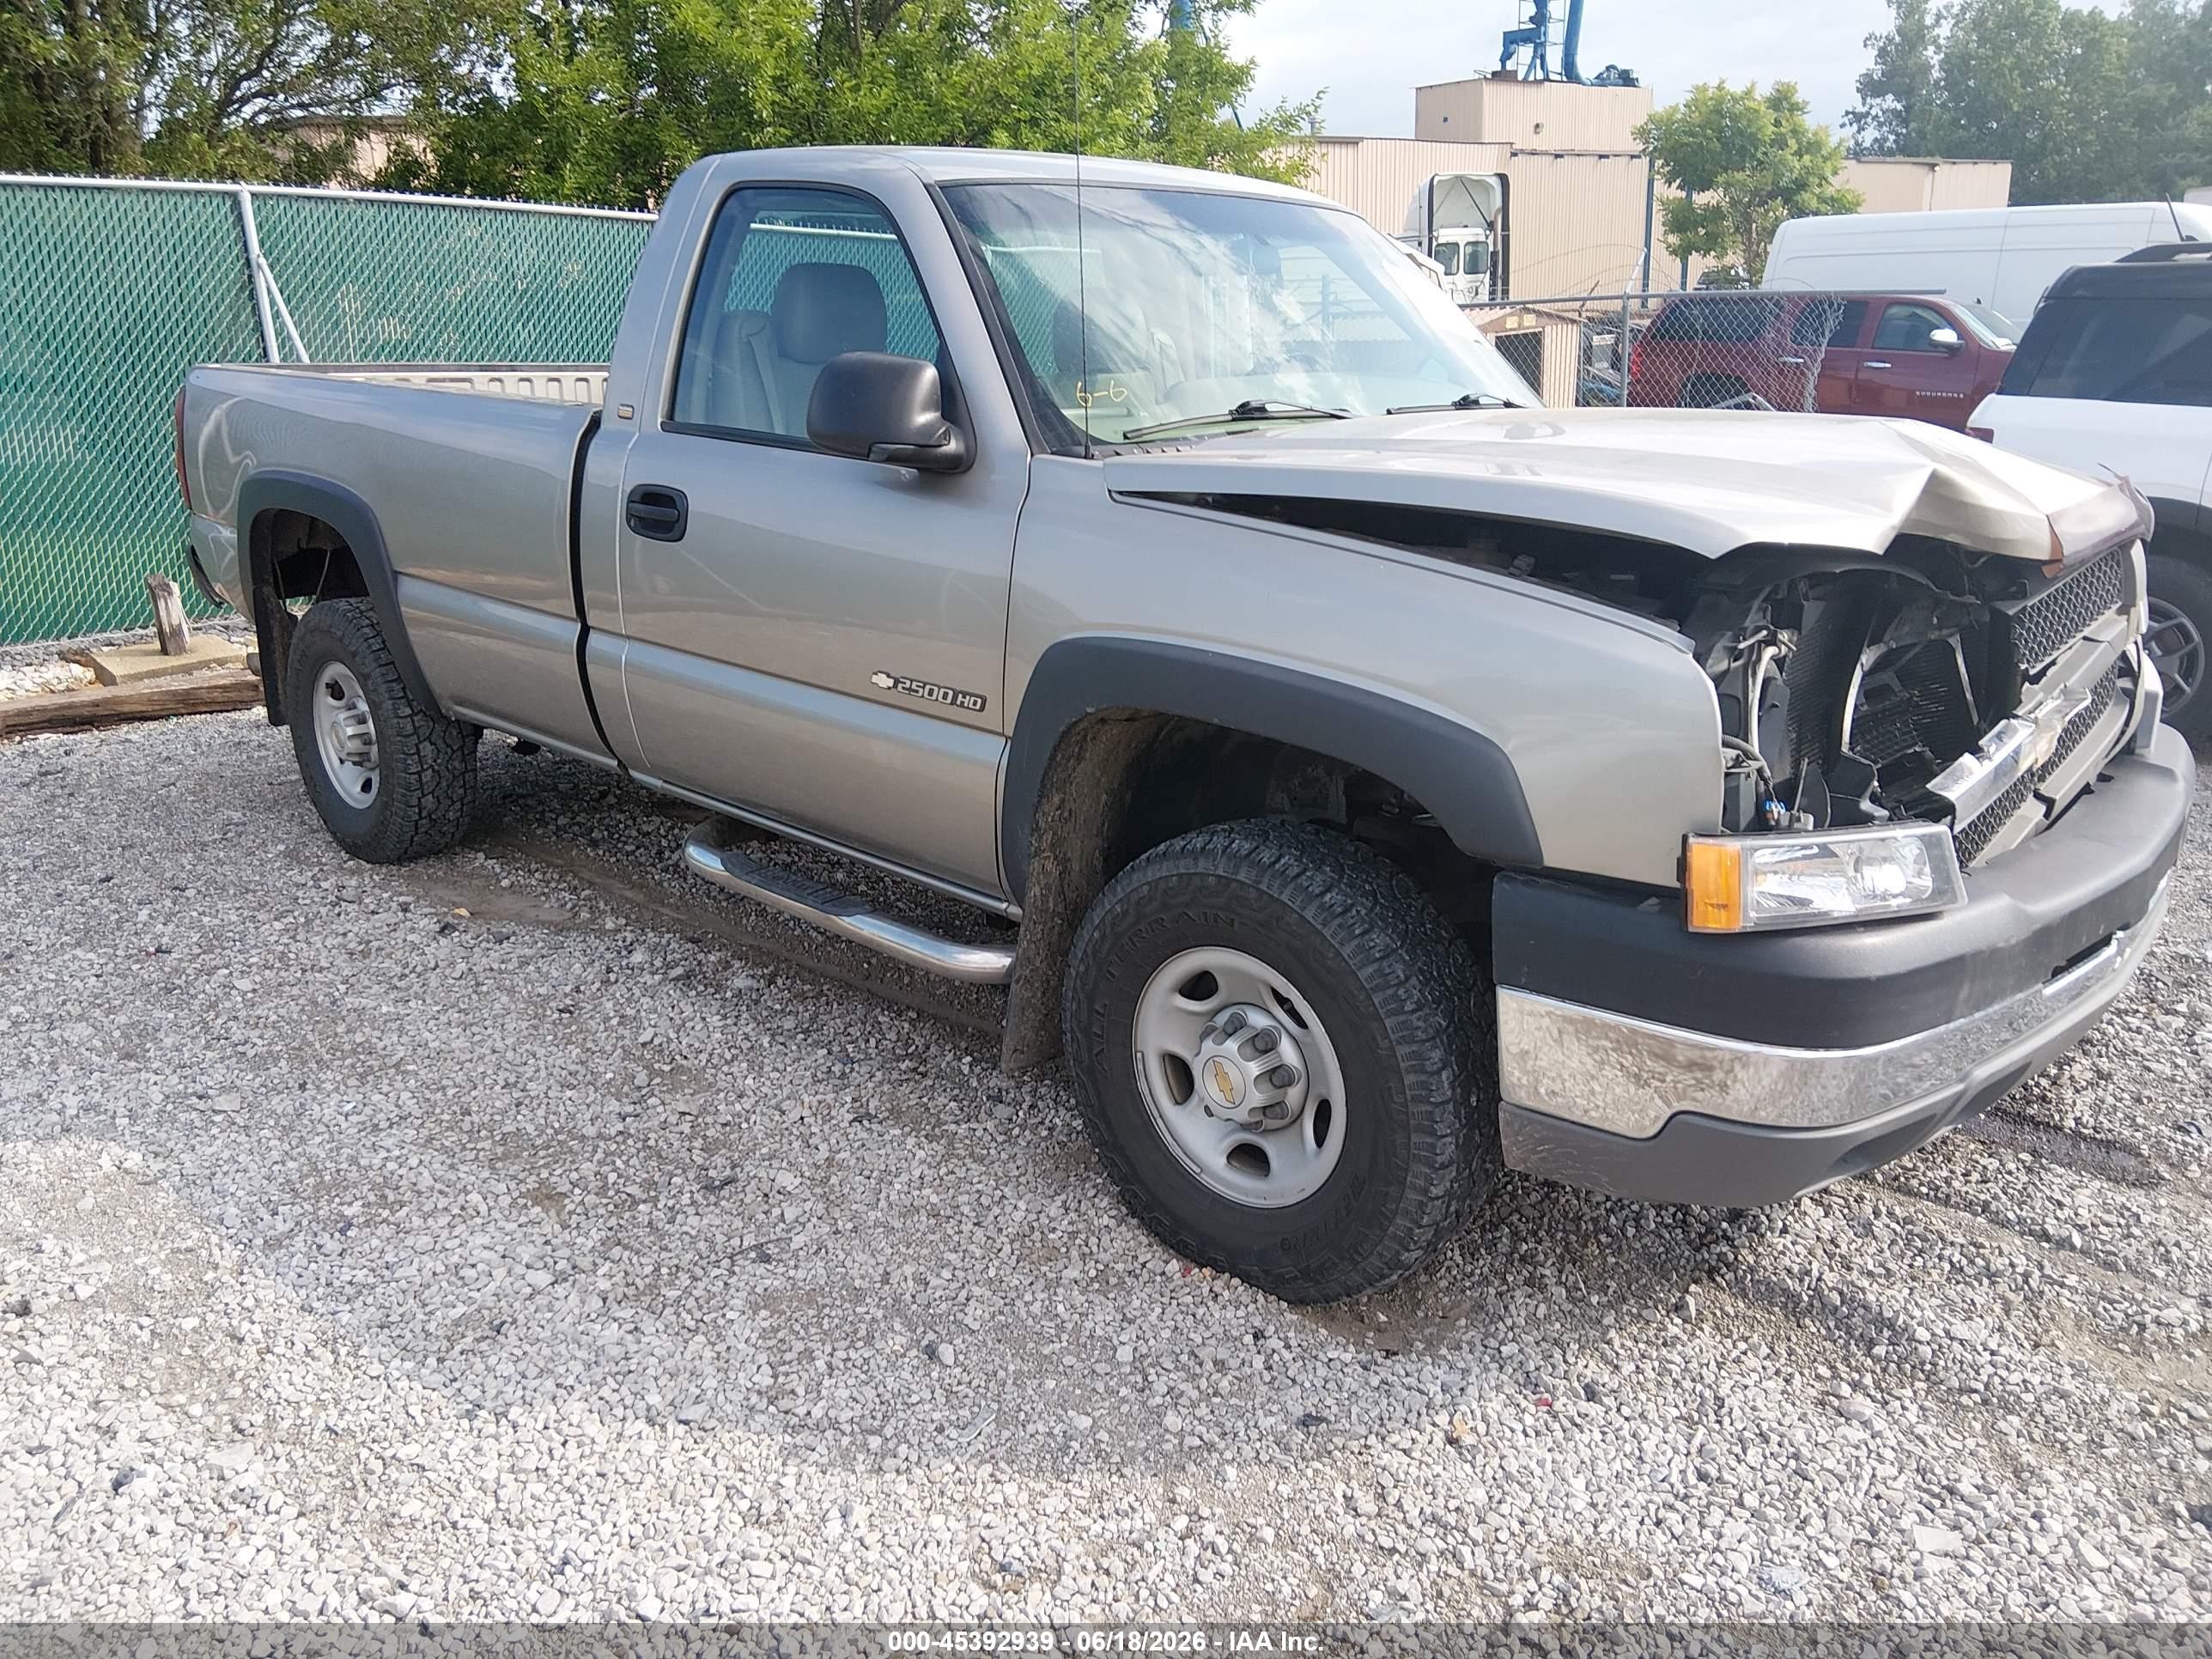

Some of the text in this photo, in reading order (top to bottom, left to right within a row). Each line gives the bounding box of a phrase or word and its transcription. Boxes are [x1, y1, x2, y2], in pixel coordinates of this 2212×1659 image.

[896, 678, 983, 711] 2500 HD
[1091, 910, 1237, 1074] ALL TERRAIN
